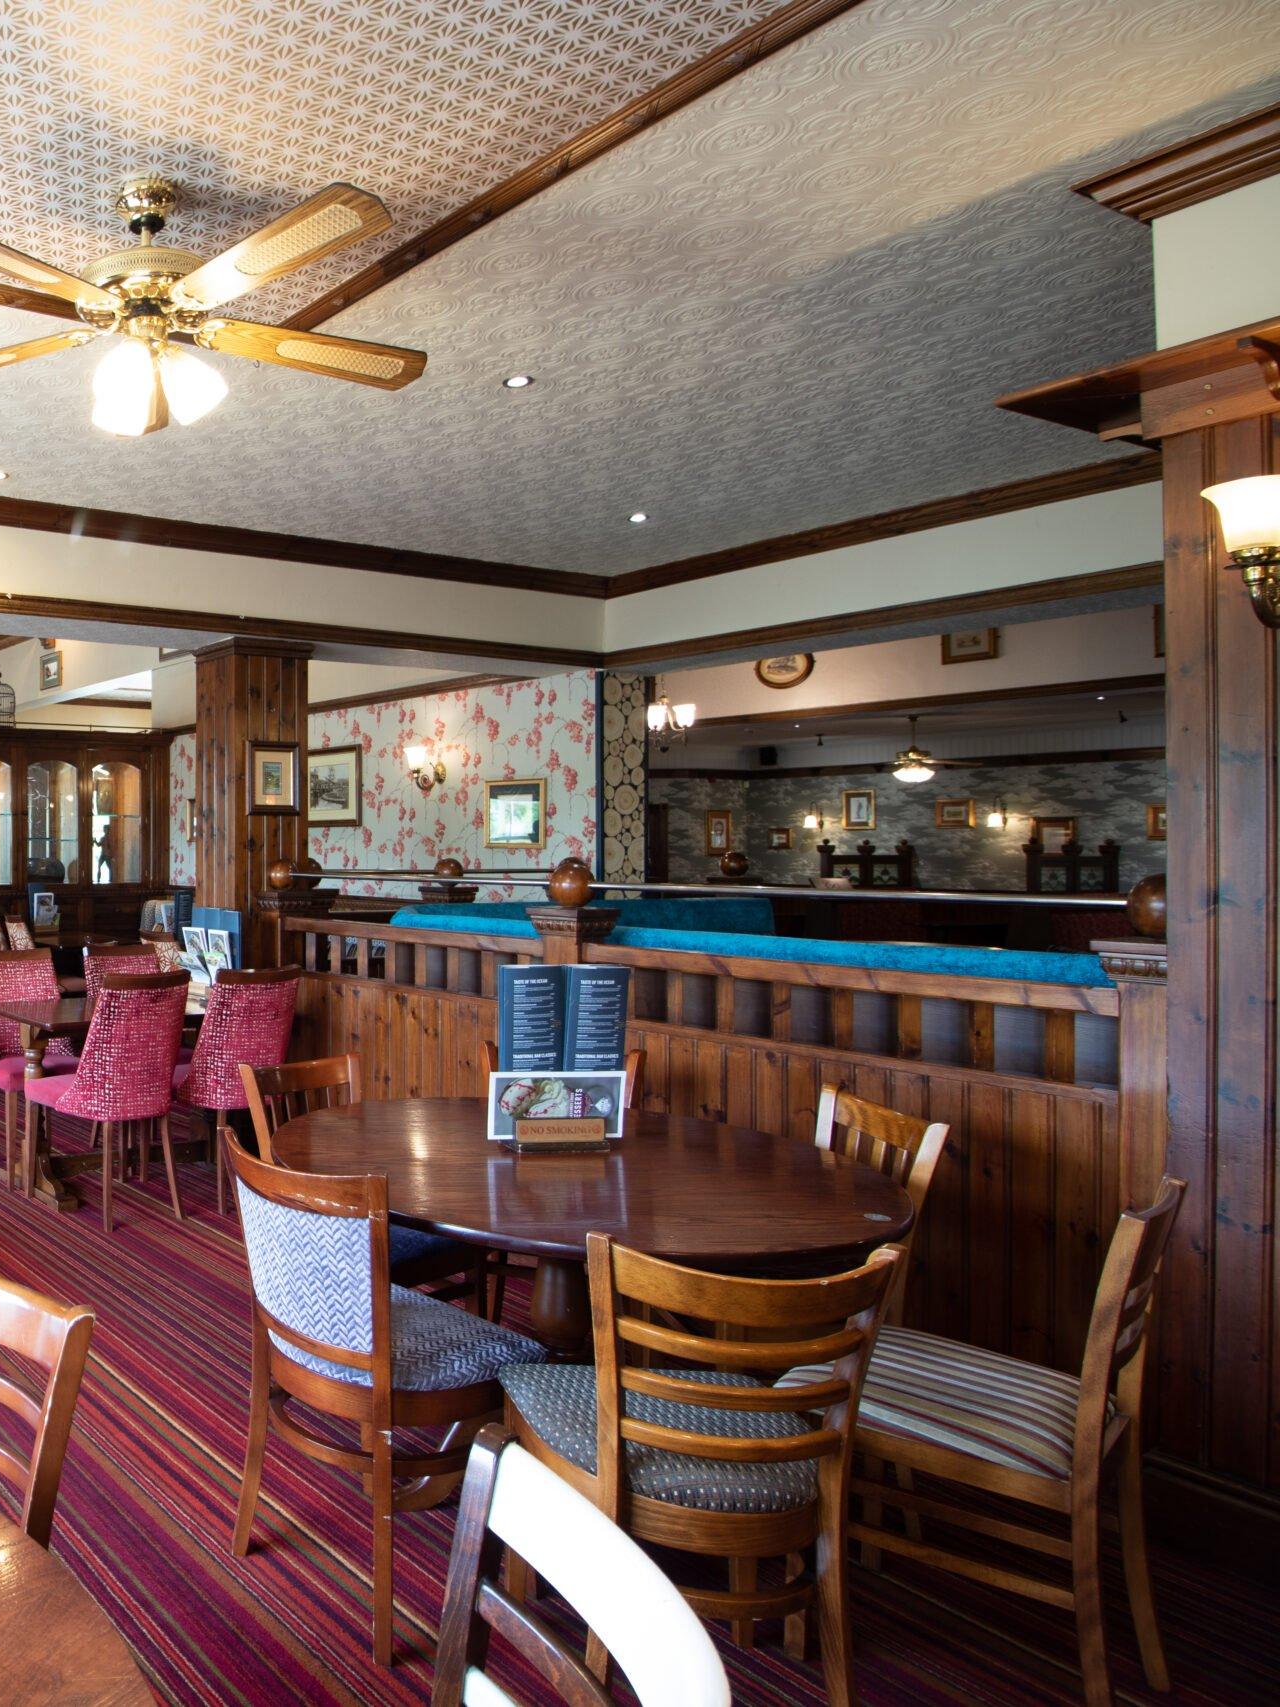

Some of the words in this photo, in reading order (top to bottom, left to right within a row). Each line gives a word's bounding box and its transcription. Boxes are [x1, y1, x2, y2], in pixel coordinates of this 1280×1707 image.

[573, 1088, 583, 1118] ESSERTS
[530, 1125, 544, 1135] NO
[546, 1125, 592, 1135] SMOKING
